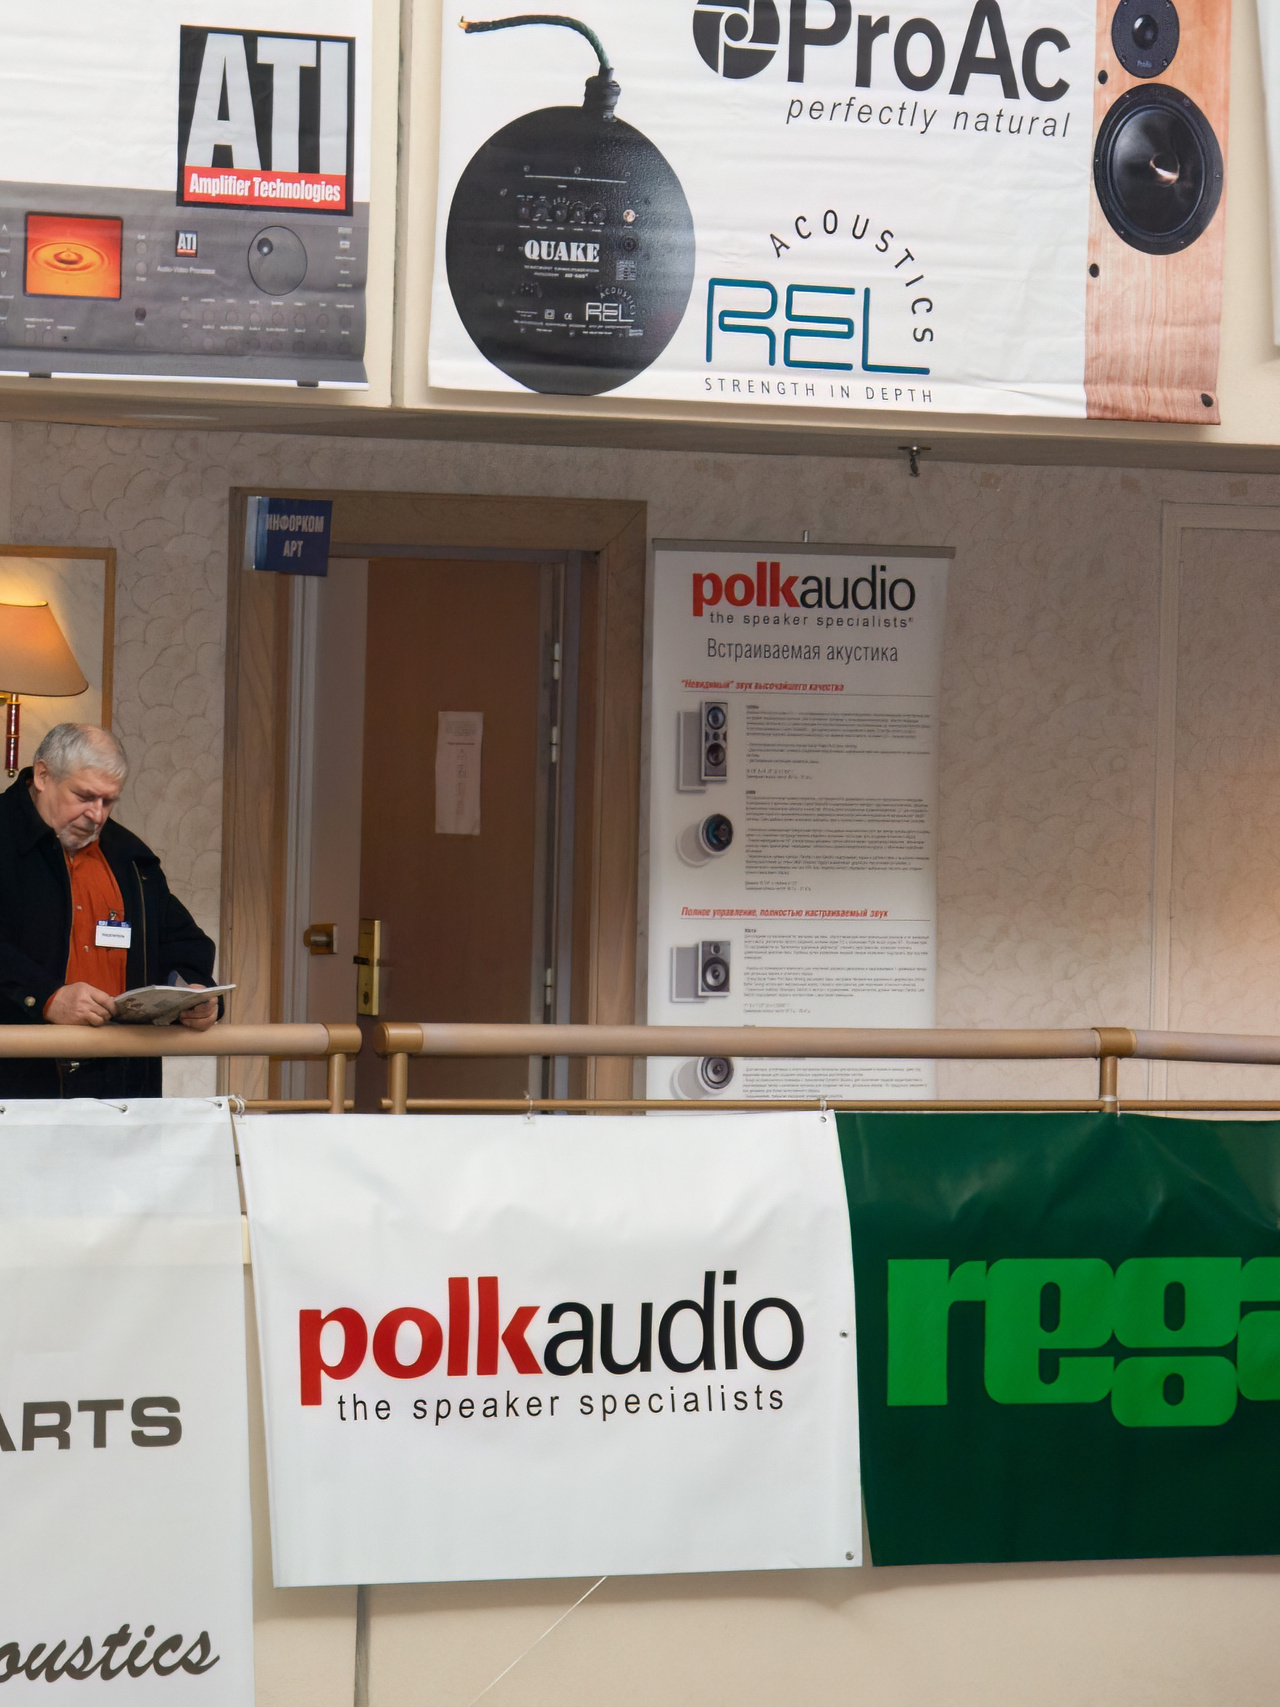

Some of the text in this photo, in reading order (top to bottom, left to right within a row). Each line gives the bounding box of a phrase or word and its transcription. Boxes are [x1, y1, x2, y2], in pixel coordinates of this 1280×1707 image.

[787, 0, 1071, 102] ProAc
[184, 32, 348, 175] ATI
[786, 97, 1071, 137] perfectly natural
[189, 173, 341, 202] Amplifier Technologies
[177, 232, 197, 250] ATI
[524, 239, 600, 263] QUAKE
[770, 209, 933, 342] ACOUSTICS
[705, 277, 931, 376] REL
[704, 377, 932, 403] STRENGTH IN DEPTH
[265, 513, 324, 533] ИНФОРКОМ
[282, 540, 303, 557] АРТ
[692, 561, 916, 617] polkaudio
[710, 612, 734, 624] the
[743, 613, 809, 627] speaker
[707, 638, 898, 665] Встраиваемая акустика
[681, 906, 710, 917] Полное
[759, 908, 802, 917] полностью
[805, 908, 868, 919] настраиваемый
[869, 909, 889, 919] звук
[299, 1270, 804, 1406] polkaudio
[338, 1385, 784, 1426] the speaker specialists
